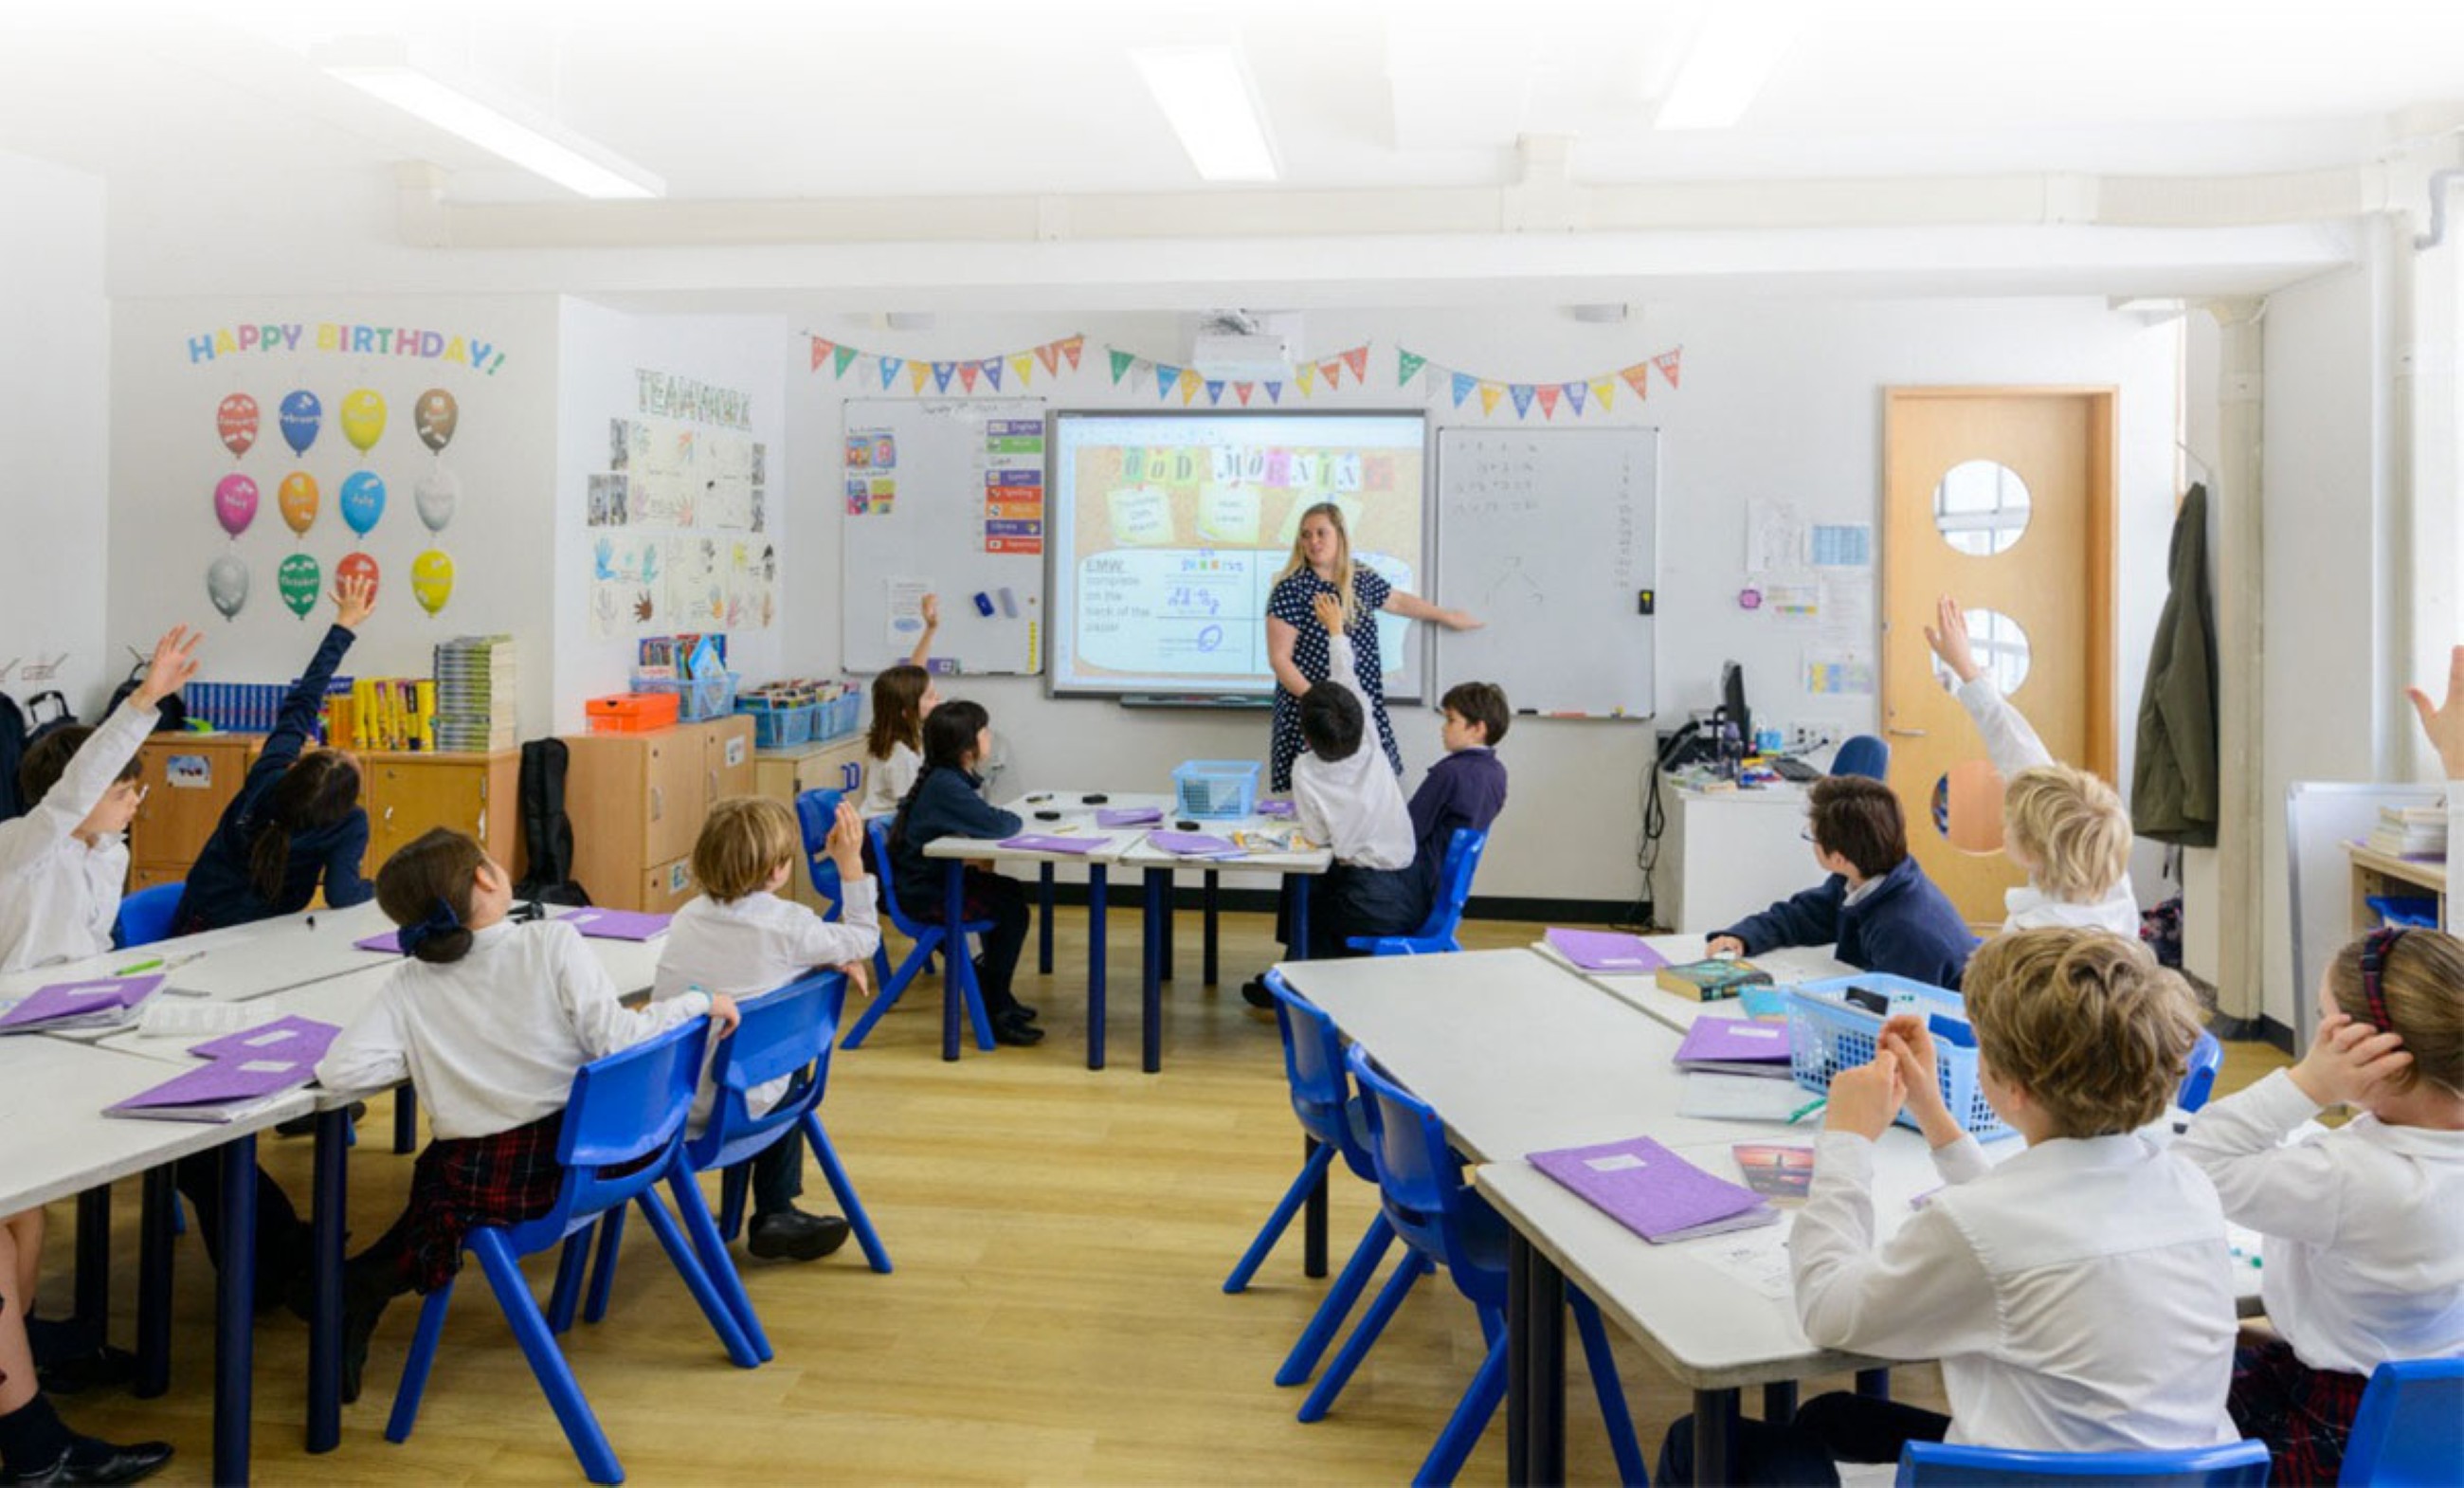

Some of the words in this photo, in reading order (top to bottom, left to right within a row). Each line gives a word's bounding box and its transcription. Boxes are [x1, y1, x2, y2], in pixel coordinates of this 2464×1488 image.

[188, 323, 302, 364] HAPPY
[317, 322, 506, 375] BIRTHDAY!
[634, 368, 753, 432] TEAMWORK
[1086, 559, 1125, 572] EMW
